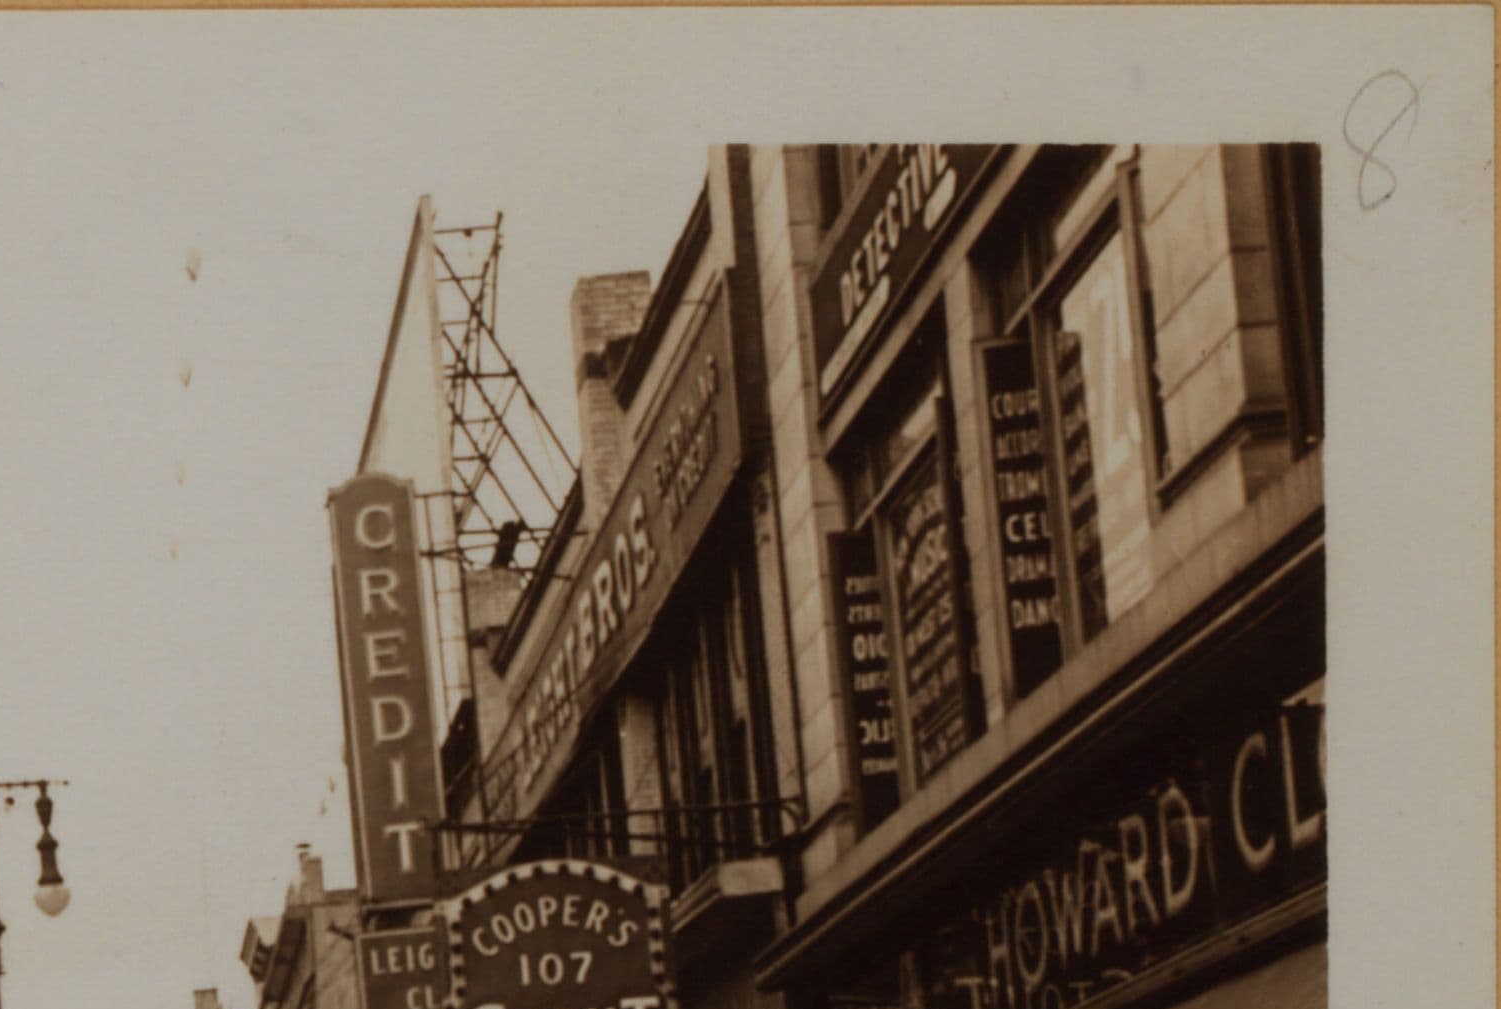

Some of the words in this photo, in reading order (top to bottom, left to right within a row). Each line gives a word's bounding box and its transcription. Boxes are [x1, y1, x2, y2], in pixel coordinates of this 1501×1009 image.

[1342, 68, 1421, 212] 8
[355, 508, 426, 873] CREDIT
[1230, 714, 1326, 872] CL
[472, 893, 639, 956] COOPER'S
[519, 951, 595, 986] 107
